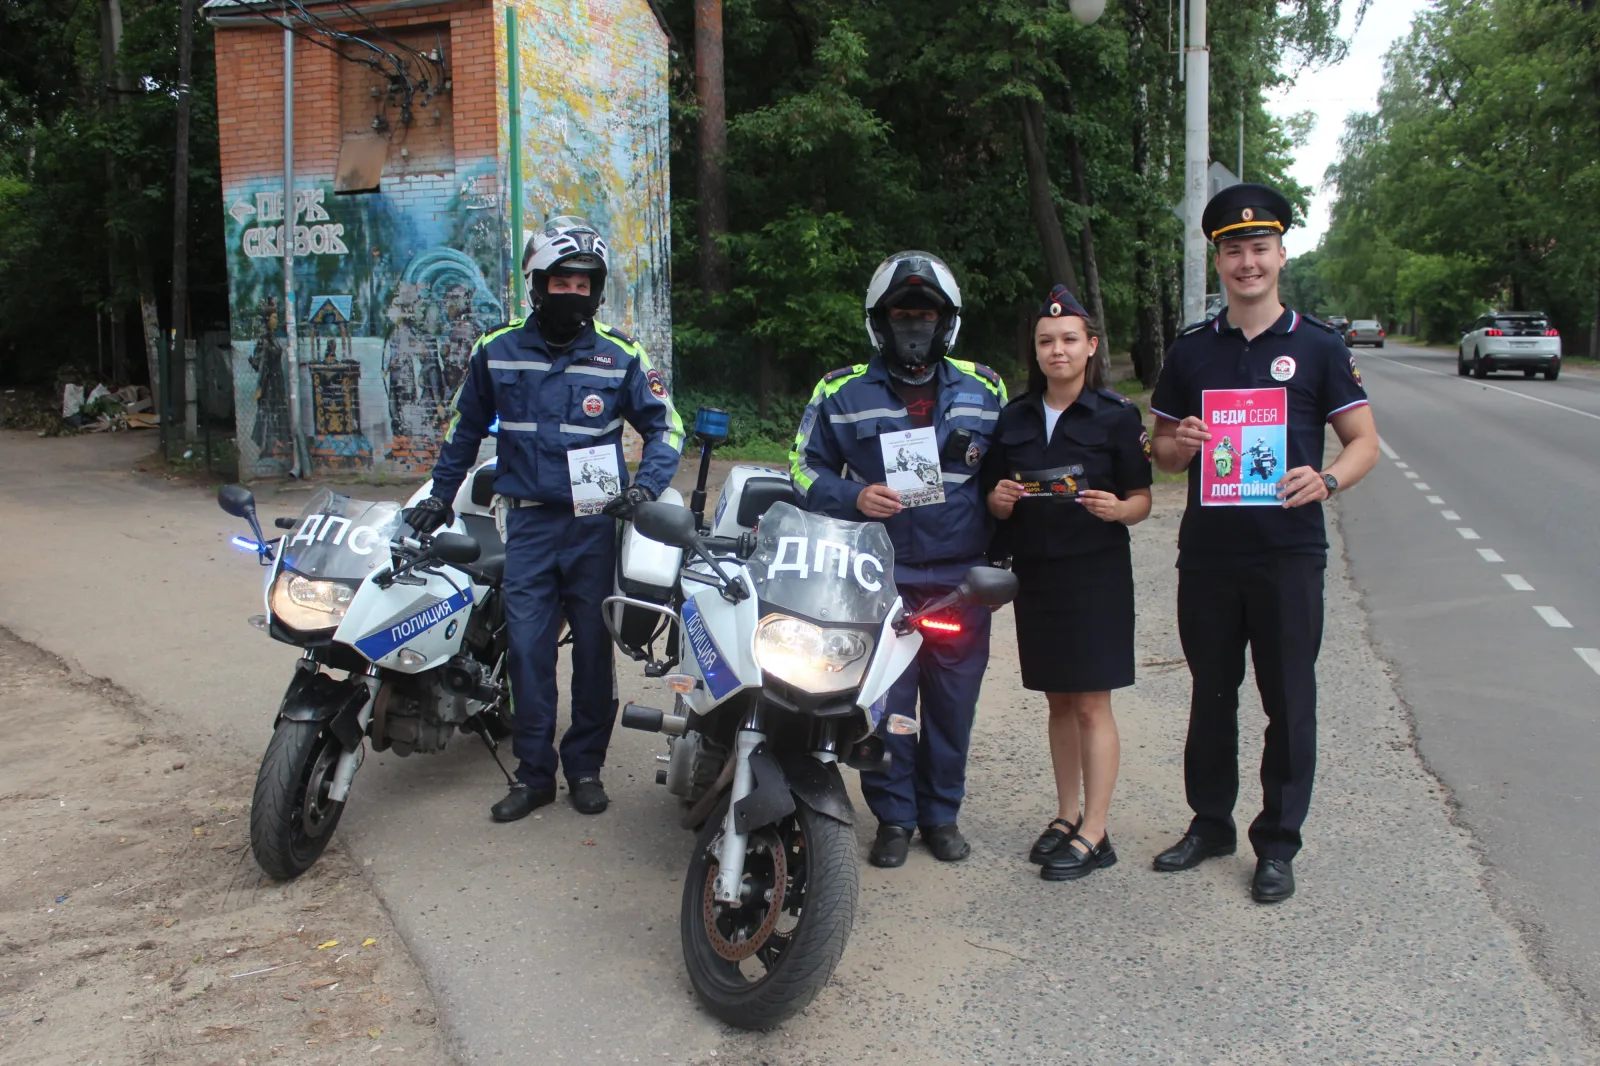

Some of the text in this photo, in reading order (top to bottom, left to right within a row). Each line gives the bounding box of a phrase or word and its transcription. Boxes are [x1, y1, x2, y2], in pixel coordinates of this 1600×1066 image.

[1212, 408, 1278, 425] ВЕДИ СЕБЯ
[1211, 480, 1277, 497] ДОСТОЙНО
[289, 514, 381, 555] ДПС
[767, 536, 885, 592] ДПС
[391, 600, 453, 642] ПОЛИЦИЯ
[686, 611, 717, 671] ПОЛИЦИЯ
